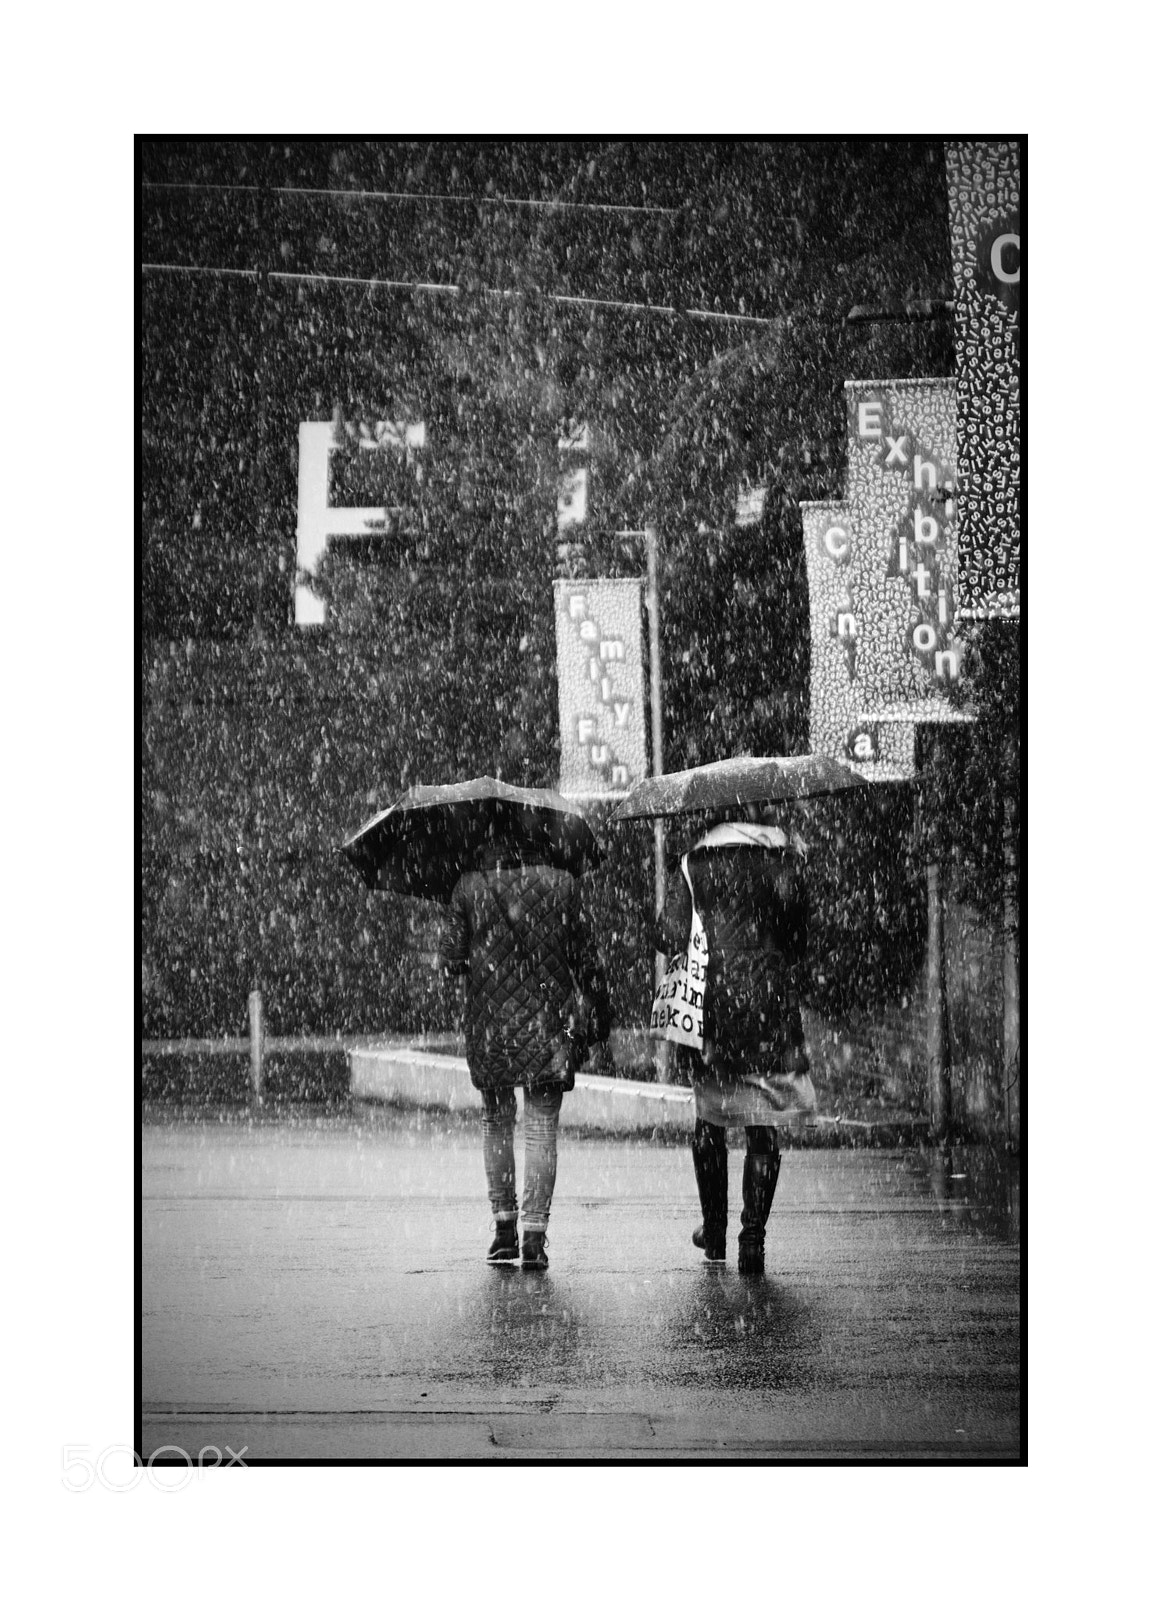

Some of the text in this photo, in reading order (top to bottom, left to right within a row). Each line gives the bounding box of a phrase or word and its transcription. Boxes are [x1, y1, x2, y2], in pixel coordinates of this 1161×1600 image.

[859, 402, 958, 679] Exhibition
[569, 595, 630, 726] Family
[824, 526, 874, 757] Cna
[578, 719, 628, 784] Fun
